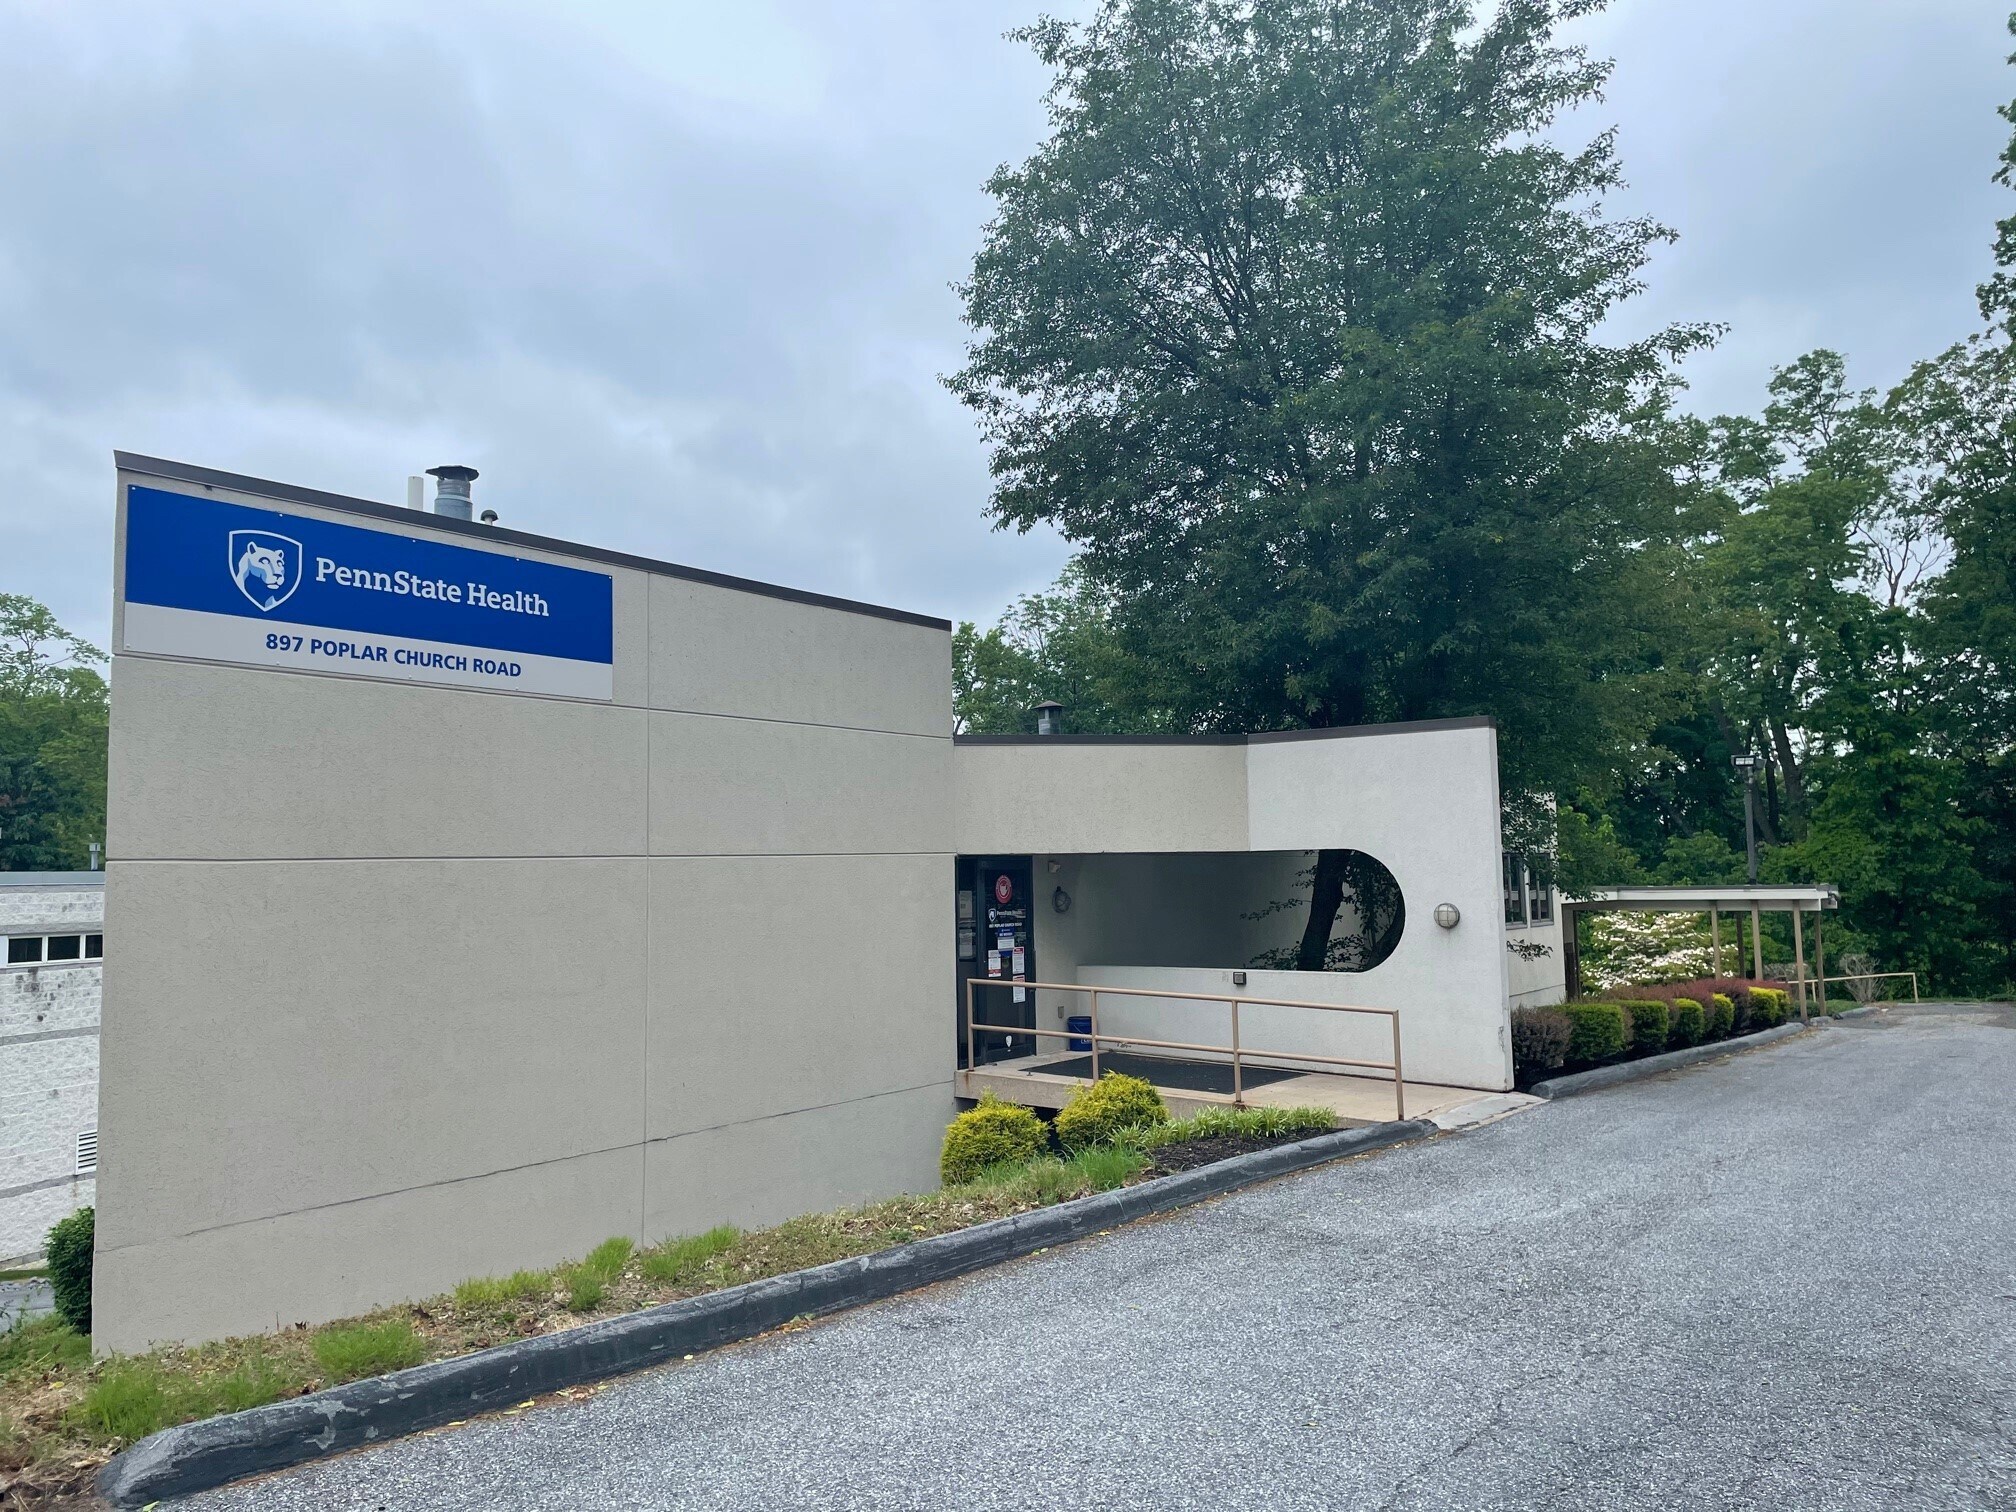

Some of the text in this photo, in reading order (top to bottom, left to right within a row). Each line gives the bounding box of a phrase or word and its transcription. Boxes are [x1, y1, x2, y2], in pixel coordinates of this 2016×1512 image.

[316, 557, 549, 617] PennState Health
[266, 633, 522, 677] 897 POPLAR CHURCH ROAD
